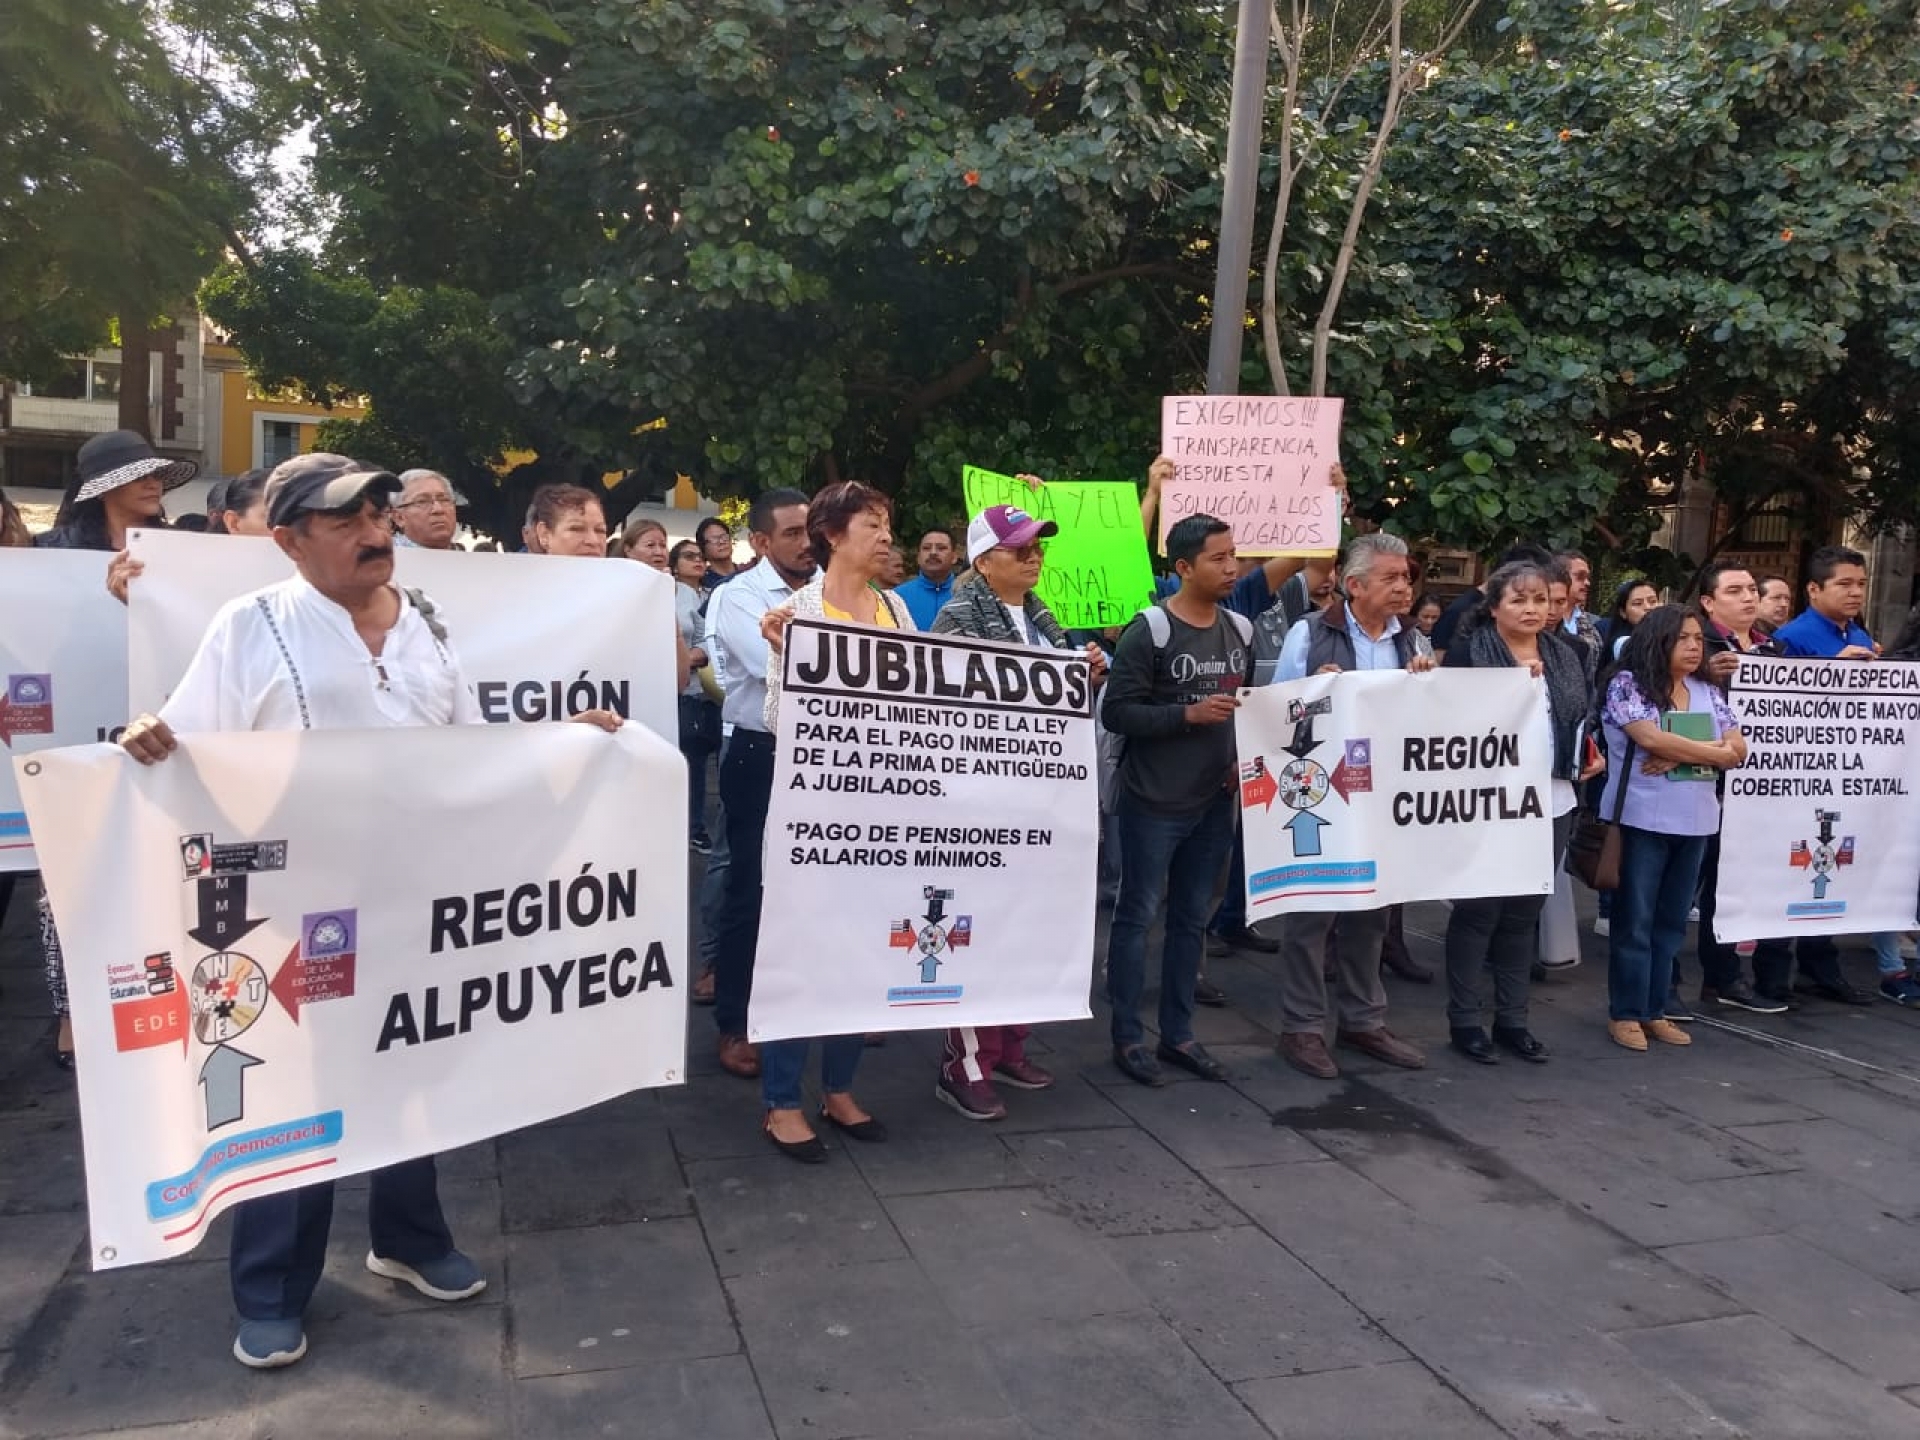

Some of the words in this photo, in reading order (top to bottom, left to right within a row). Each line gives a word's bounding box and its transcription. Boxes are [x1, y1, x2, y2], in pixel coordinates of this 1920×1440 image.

[1172, 435, 1318, 458] TRANSPARENCIA,
[1174, 464, 1273, 482] RESPUESTA
[1068, 489, 1086, 528] Y
[1097, 489, 1134, 528] EL
[1268, 494, 1278, 514] A
[1286, 495, 1323, 517] LOS
[1232, 523, 1324, 546] LOGADOS
[796, 632, 1088, 709] JUBILADOS
[1739, 663, 1846, 688] EDUCACIÓN
[1848, 668, 1919, 689] ESPECIA
[470, 671, 630, 723] EGIÓN
[1844, 701, 1867, 720] DE
[974, 714, 999, 730] DE
[1005, 716, 1029, 732] LA
[1034, 718, 1068, 735] LEY
[1741, 725, 1858, 745] PRESUPUESTO
[1862, 726, 1906, 745] PARA
[795, 723, 860, 744] PARA
[866, 728, 893, 746] EL
[899, 730, 954, 750] PAGO
[960, 734, 1063, 757] INMEDIATO
[1402, 726, 1519, 772] REGIÓN
[793, 747, 825, 766] DE
[833, 749, 863, 768] LA
[869, 752, 936, 772] PRIMA
[941, 756, 967, 774] DE
[972, 758, 1088, 781] ANTIGÜEDAD
[1841, 752, 1864, 771] LA
[790, 773, 806, 790] A
[812, 774, 946, 797] JUBILADOS.
[1731, 777, 1834, 796] COBERTURA
[1842, 778, 1908, 796] ESTATAL.
[1392, 785, 1544, 826] CUAUTLA
[868, 825, 898, 842] DE
[905, 827, 1021, 845] PENSIONES
[1026, 829, 1052, 846] EN
[790, 846, 907, 867] SALARIOS
[914, 846, 1007, 868] MÍNIMOS.
[430, 862, 637, 954] REGIÓN
[375, 941, 673, 1054] ALPUYECA
[227, 1122, 325, 1159] Democracia
